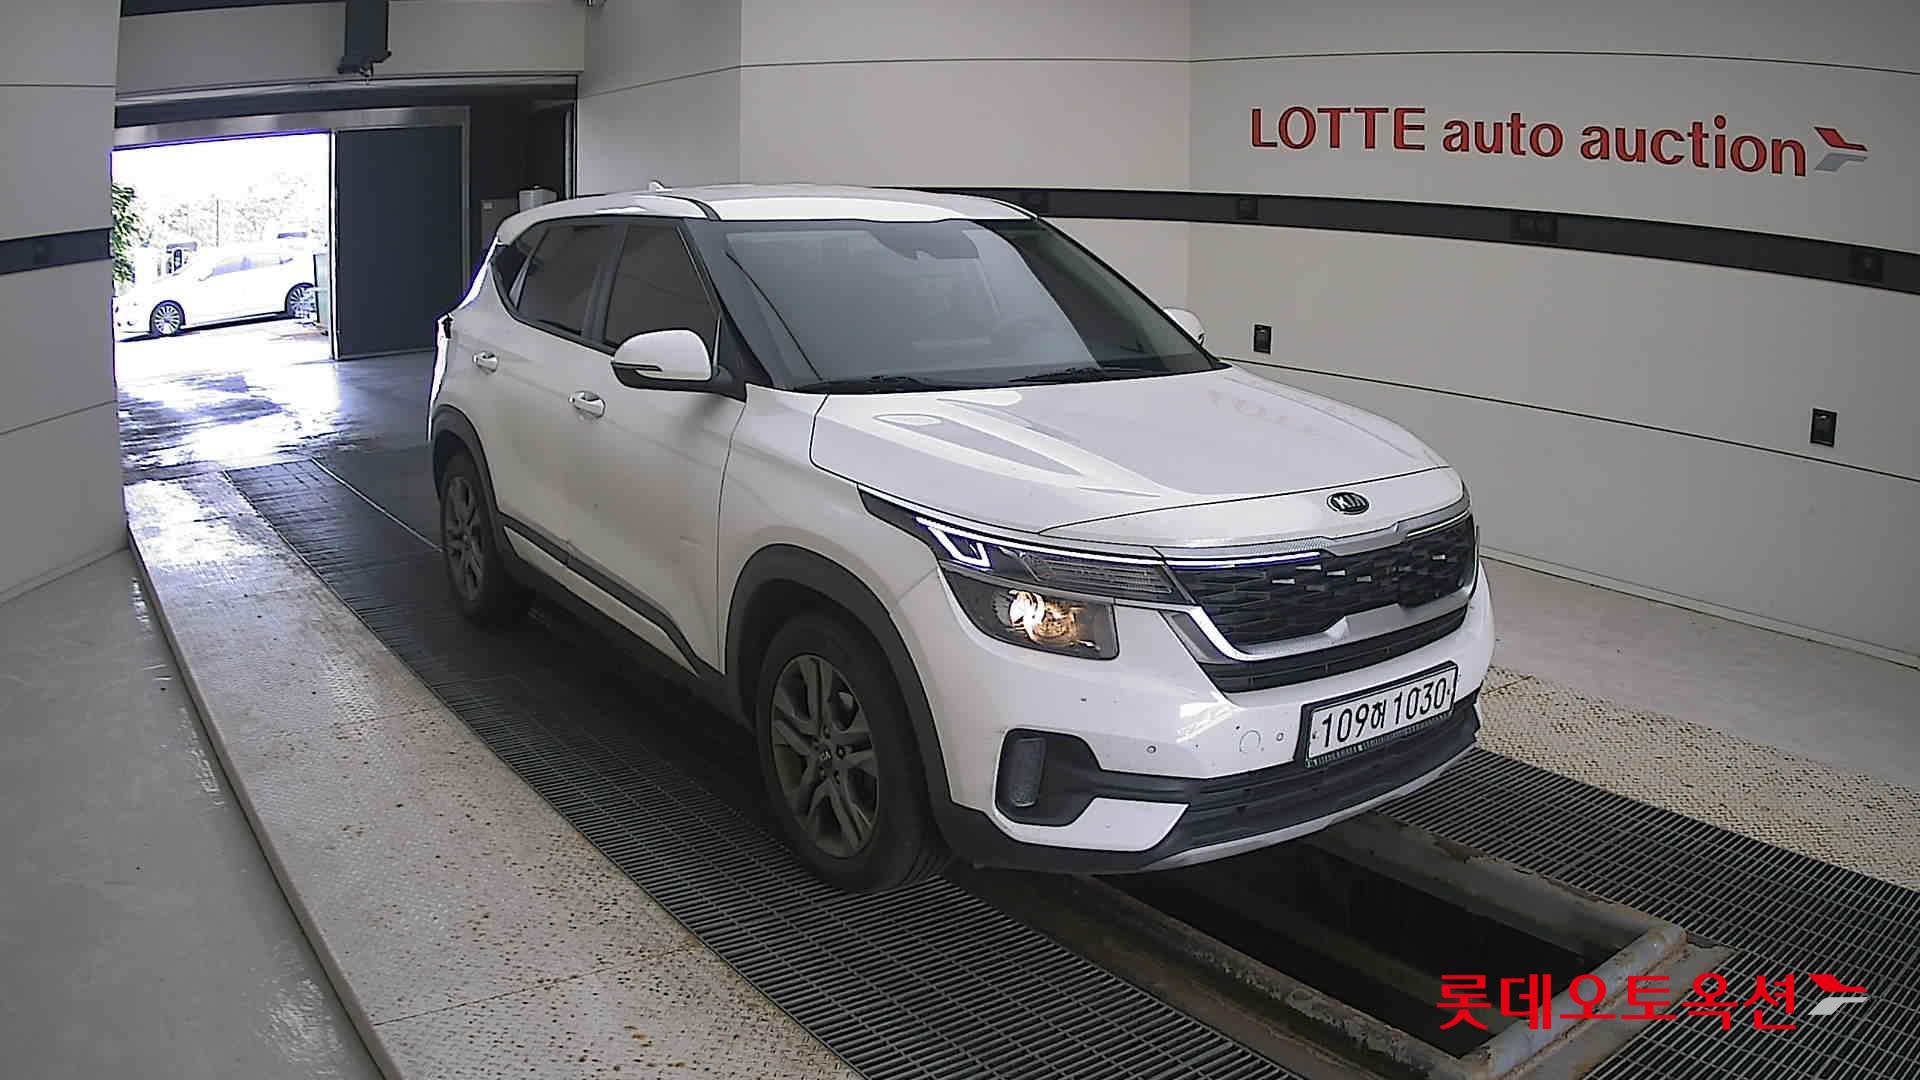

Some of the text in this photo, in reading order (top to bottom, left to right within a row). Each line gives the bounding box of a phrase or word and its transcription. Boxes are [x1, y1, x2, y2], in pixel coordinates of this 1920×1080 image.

[1250, 106, 1808, 178] LOTTE auto auction
[1394, 676, 1447, 725] 1030
